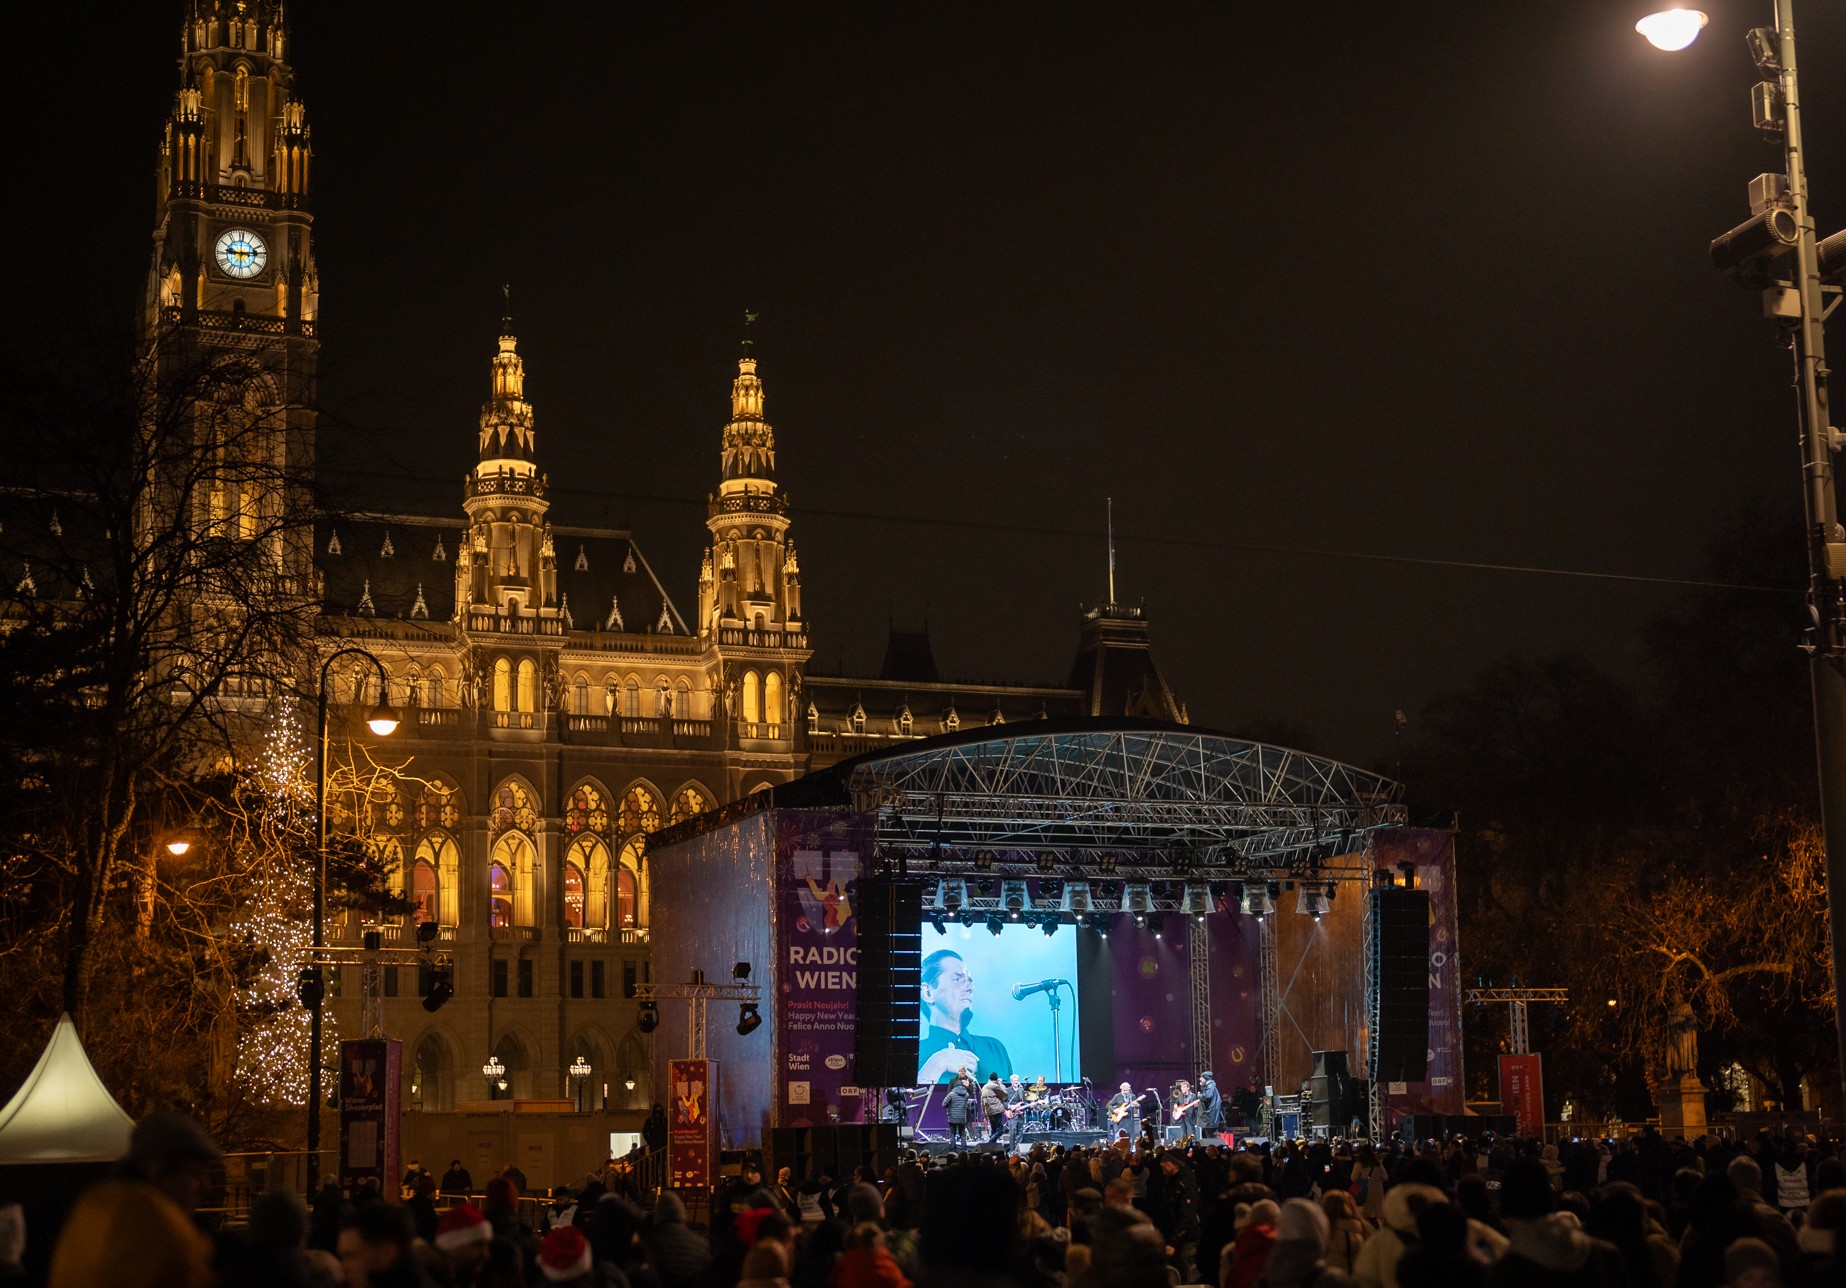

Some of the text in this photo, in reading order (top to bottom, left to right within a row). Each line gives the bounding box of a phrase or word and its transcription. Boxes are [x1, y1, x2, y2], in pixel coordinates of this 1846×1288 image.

[795, 971, 857, 990] WIEN
[788, 1001, 849, 1011] Prosit Neujahr!
[788, 1011, 856, 1021] Happy New Yea
[788, 1022, 855, 1030] Felice Anno Nuo
[788, 1053, 810, 1062] Stadt
[788, 1062, 810, 1071] Wien
